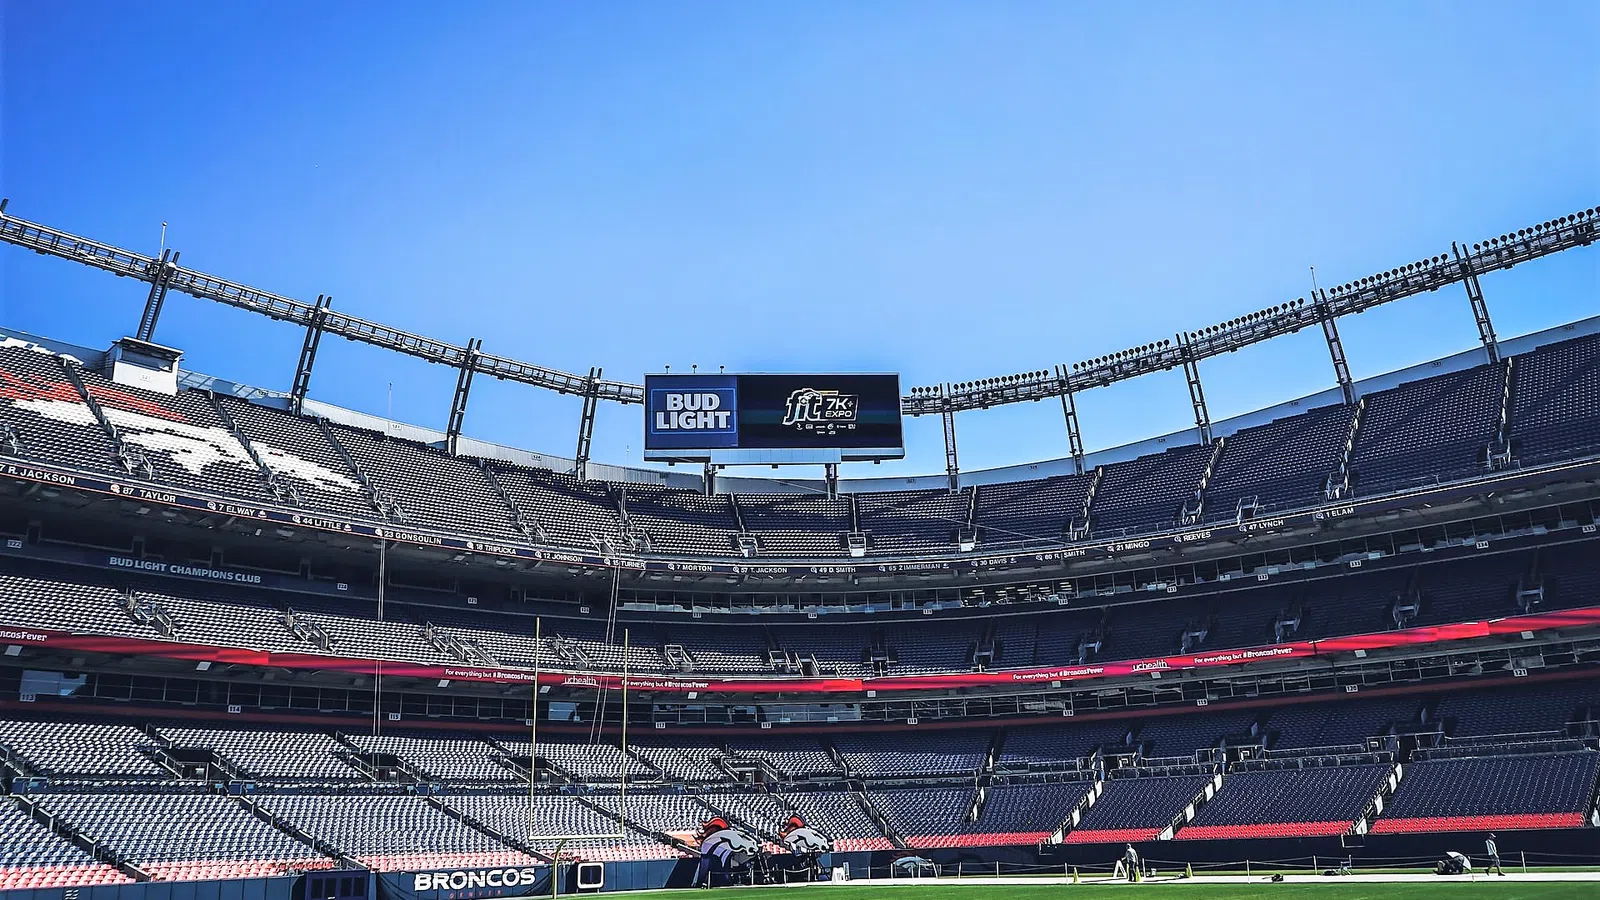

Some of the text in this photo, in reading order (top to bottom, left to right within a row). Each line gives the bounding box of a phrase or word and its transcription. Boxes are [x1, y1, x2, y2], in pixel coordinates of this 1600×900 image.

[667, 394, 720, 411] BUD
[826, 398, 853, 410] 7K+
[825, 410, 852, 418] EXPO
[656, 411, 730, 429] LIGHT
[20, 469, 75, 485] JACKSON
[123, 487, 176, 503] 87 TAYLOR
[226, 505, 255, 517] ELWAY
[1331, 508, 1354, 518] ELAM
[302, 517, 342, 530] 44 LITTLE
[1259, 520, 1284, 529] LYNCH
[383, 530, 442, 545] 23 GONSOULIN
[1183, 532, 1211, 541] REEVES
[1125, 541, 1150, 550] MINGO
[552, 553, 583, 562] JOHNSON
[1063, 550, 1085, 558] SMITH
[109, 556, 261, 583] BUD LIGHT CHAMPIONS CLUB
[898, 563, 940, 571] ZIMMERMAN
[1204, 654, 1231, 663] everything
[1132, 659, 1168, 670] uchealth
[455, 670, 482, 678] everything
[493, 671, 536, 681] #BroncosFeve
[564, 675, 597, 686] uchealth
[1022, 672, 1048, 680] everything
[630, 680, 654, 688] everything
[414, 867, 536, 891] BRONCOS
